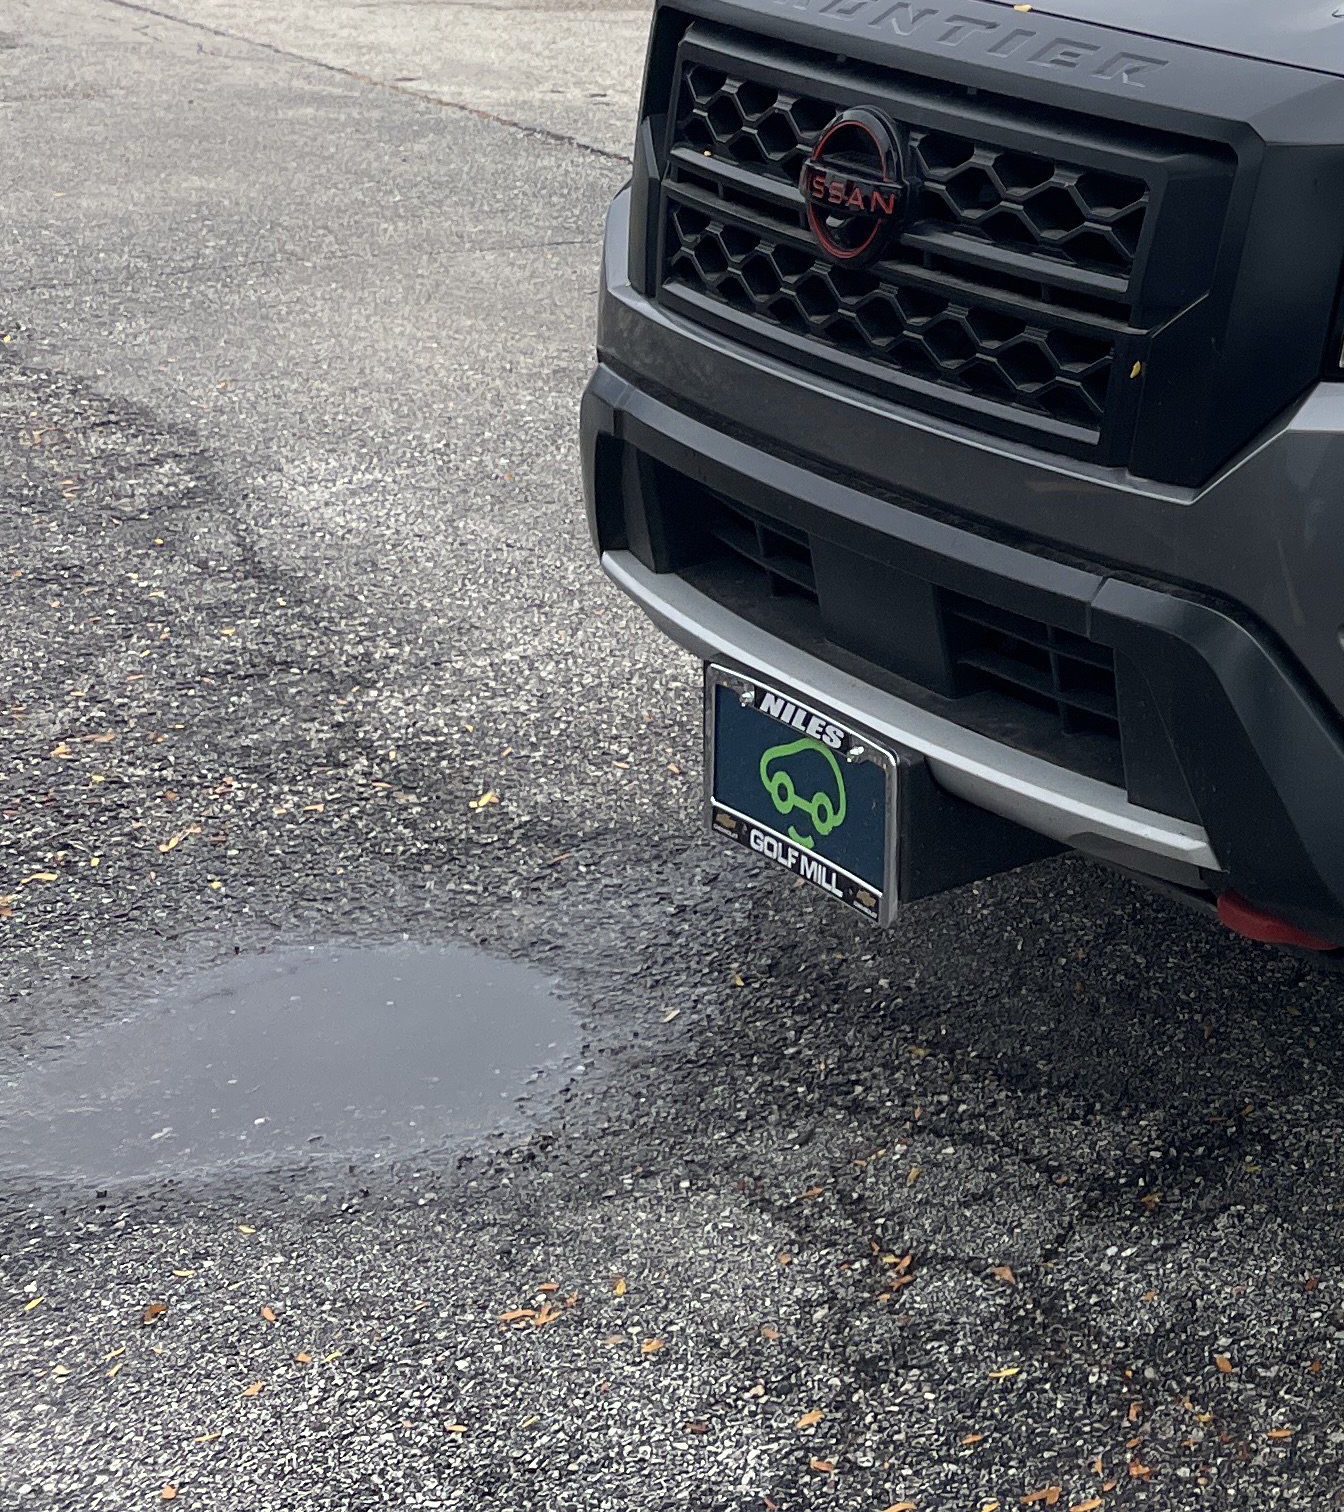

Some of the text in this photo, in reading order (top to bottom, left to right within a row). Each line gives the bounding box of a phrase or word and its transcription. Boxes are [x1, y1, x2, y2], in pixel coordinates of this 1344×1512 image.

[811, 173, 897, 216] SSAN
[759, 691, 845, 750] NILES
[750, 827, 844, 898] GOLF MILL
